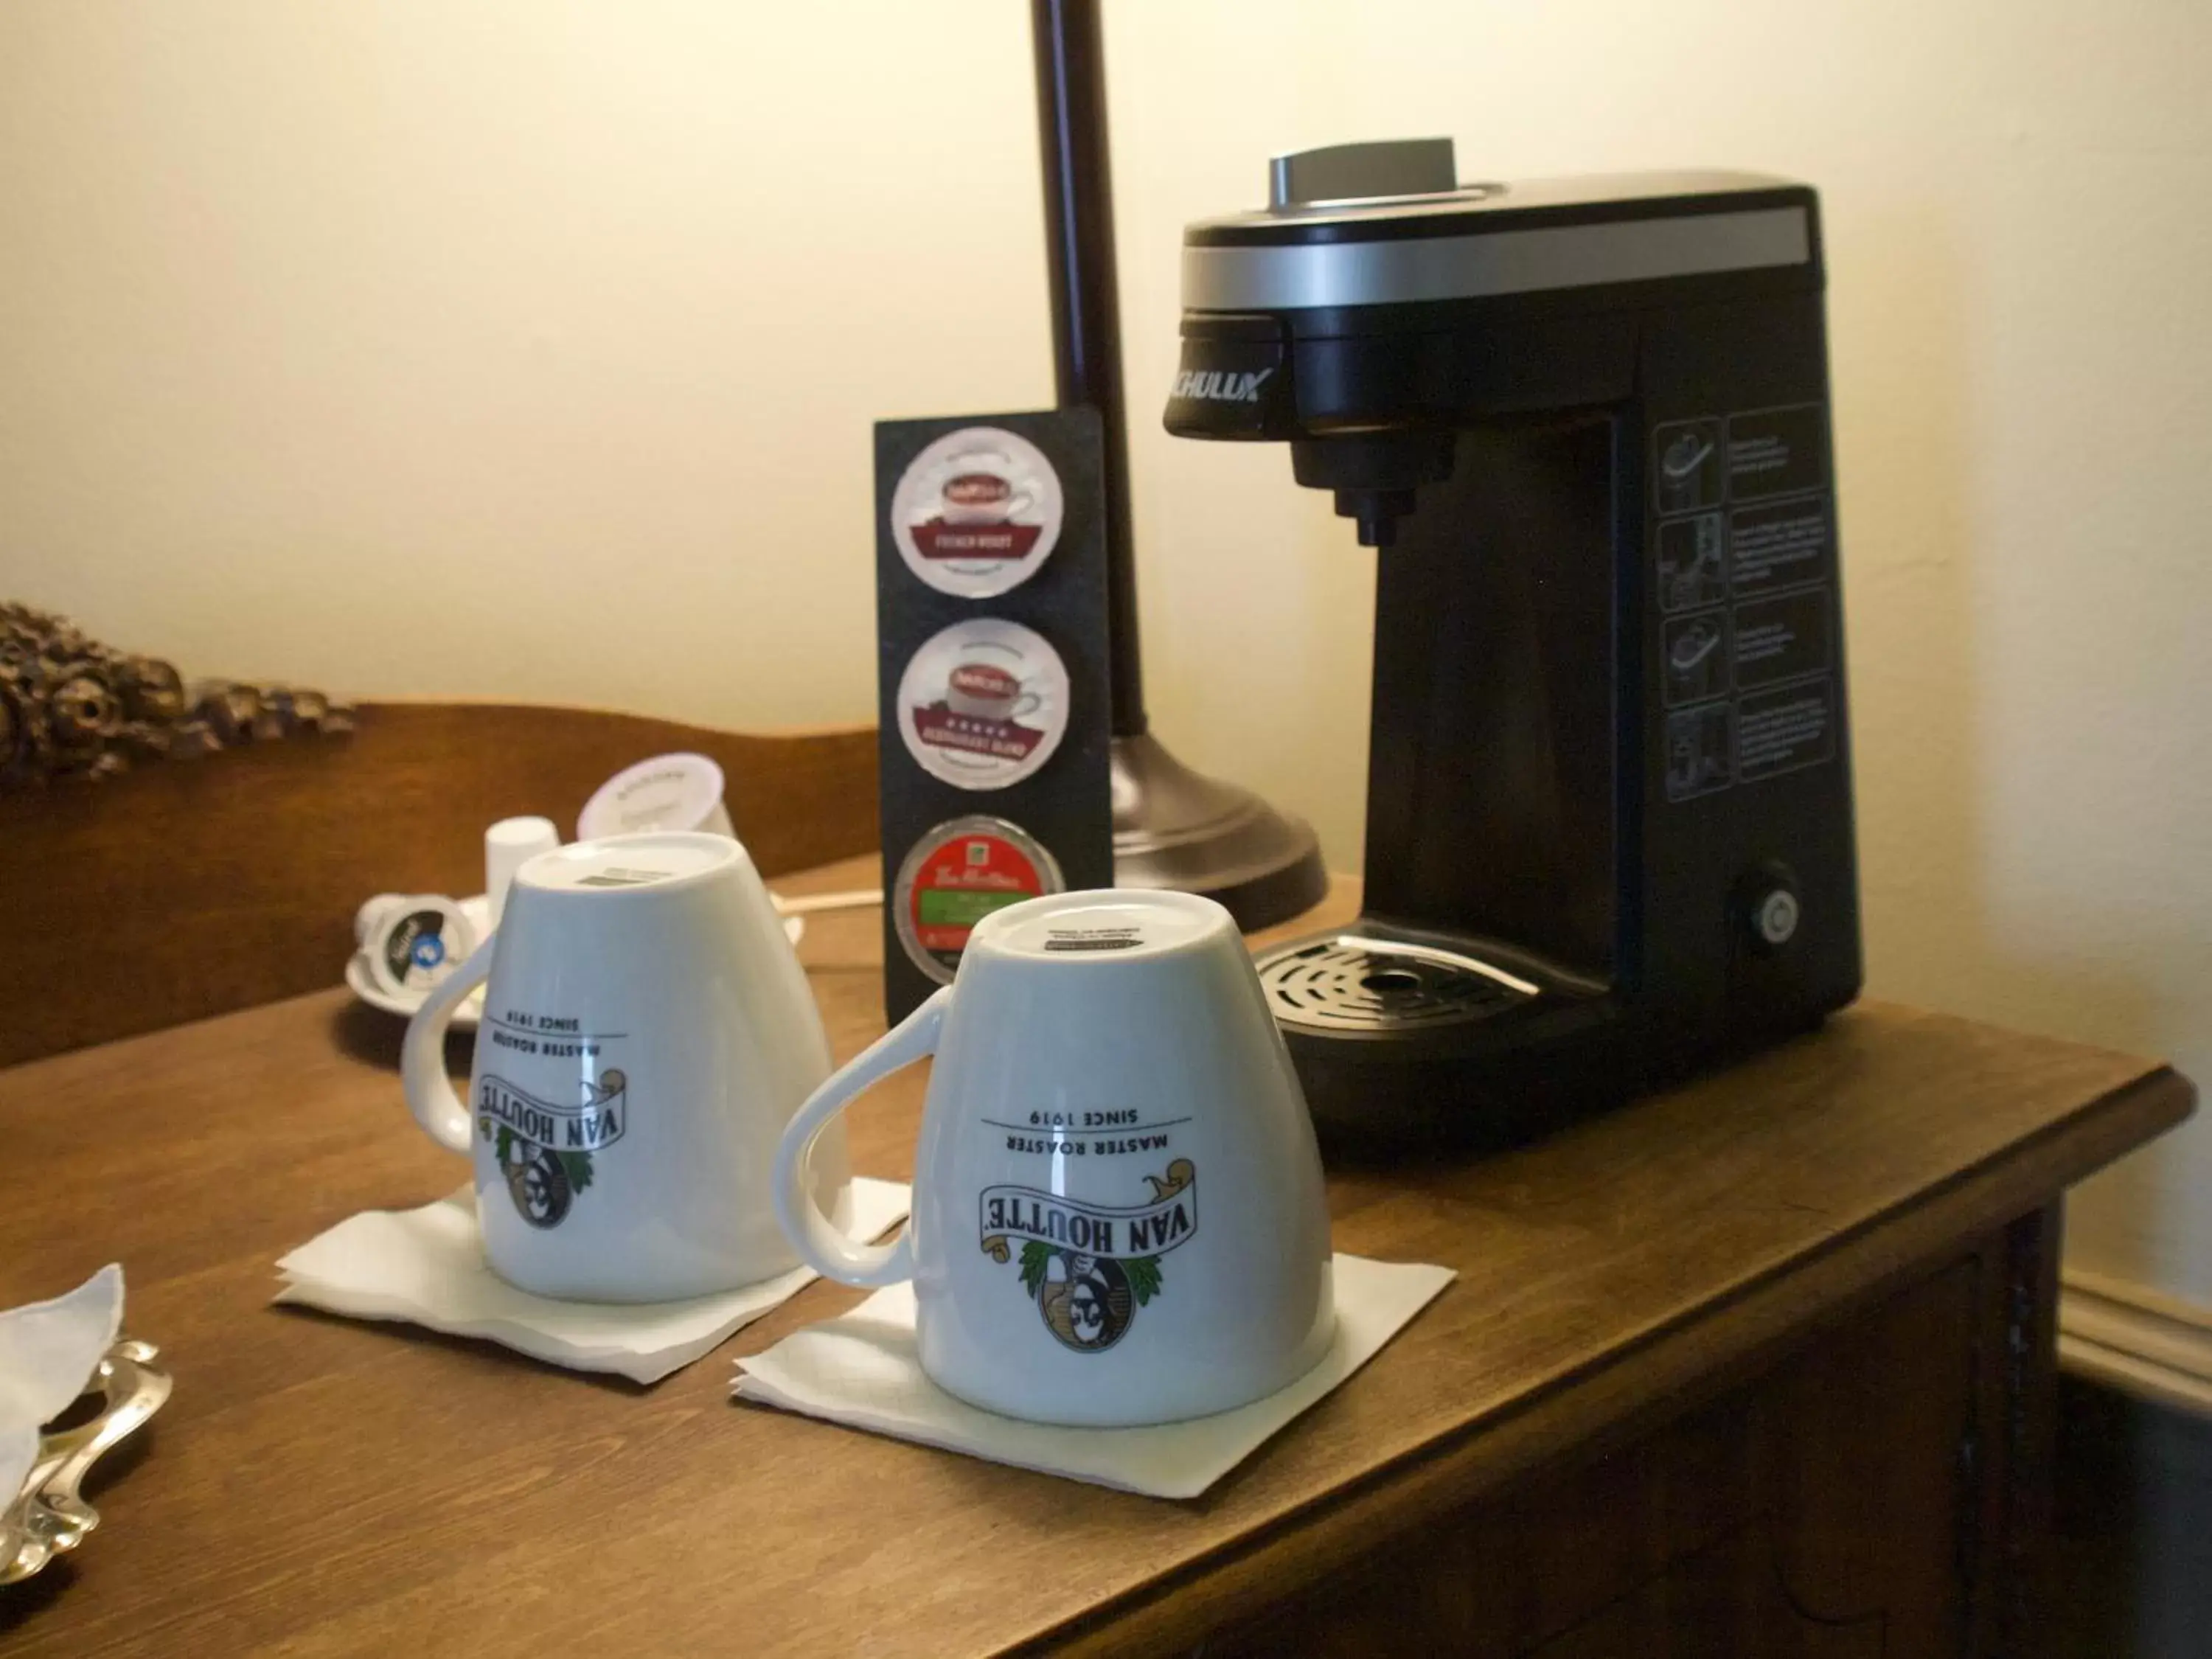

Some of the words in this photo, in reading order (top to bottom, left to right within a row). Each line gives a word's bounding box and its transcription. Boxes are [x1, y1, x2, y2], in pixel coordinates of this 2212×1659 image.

[538, 1015, 579, 1032] SINCE
[542, 1041, 601, 1057] MASTER
[481, 1085, 554, 1144] HOUTTE
[1029, 1110, 1074, 1127] 1919
[1083, 1108, 1138, 1126] SINCE
[566, 1107, 619, 1147] VAN
[1006, 1135, 1086, 1155] ROASTER
[1094, 1134, 1168, 1155] MASTER
[988, 1197, 1113, 1253] HOUTTE
[1129, 1202, 1189, 1253] VAN
